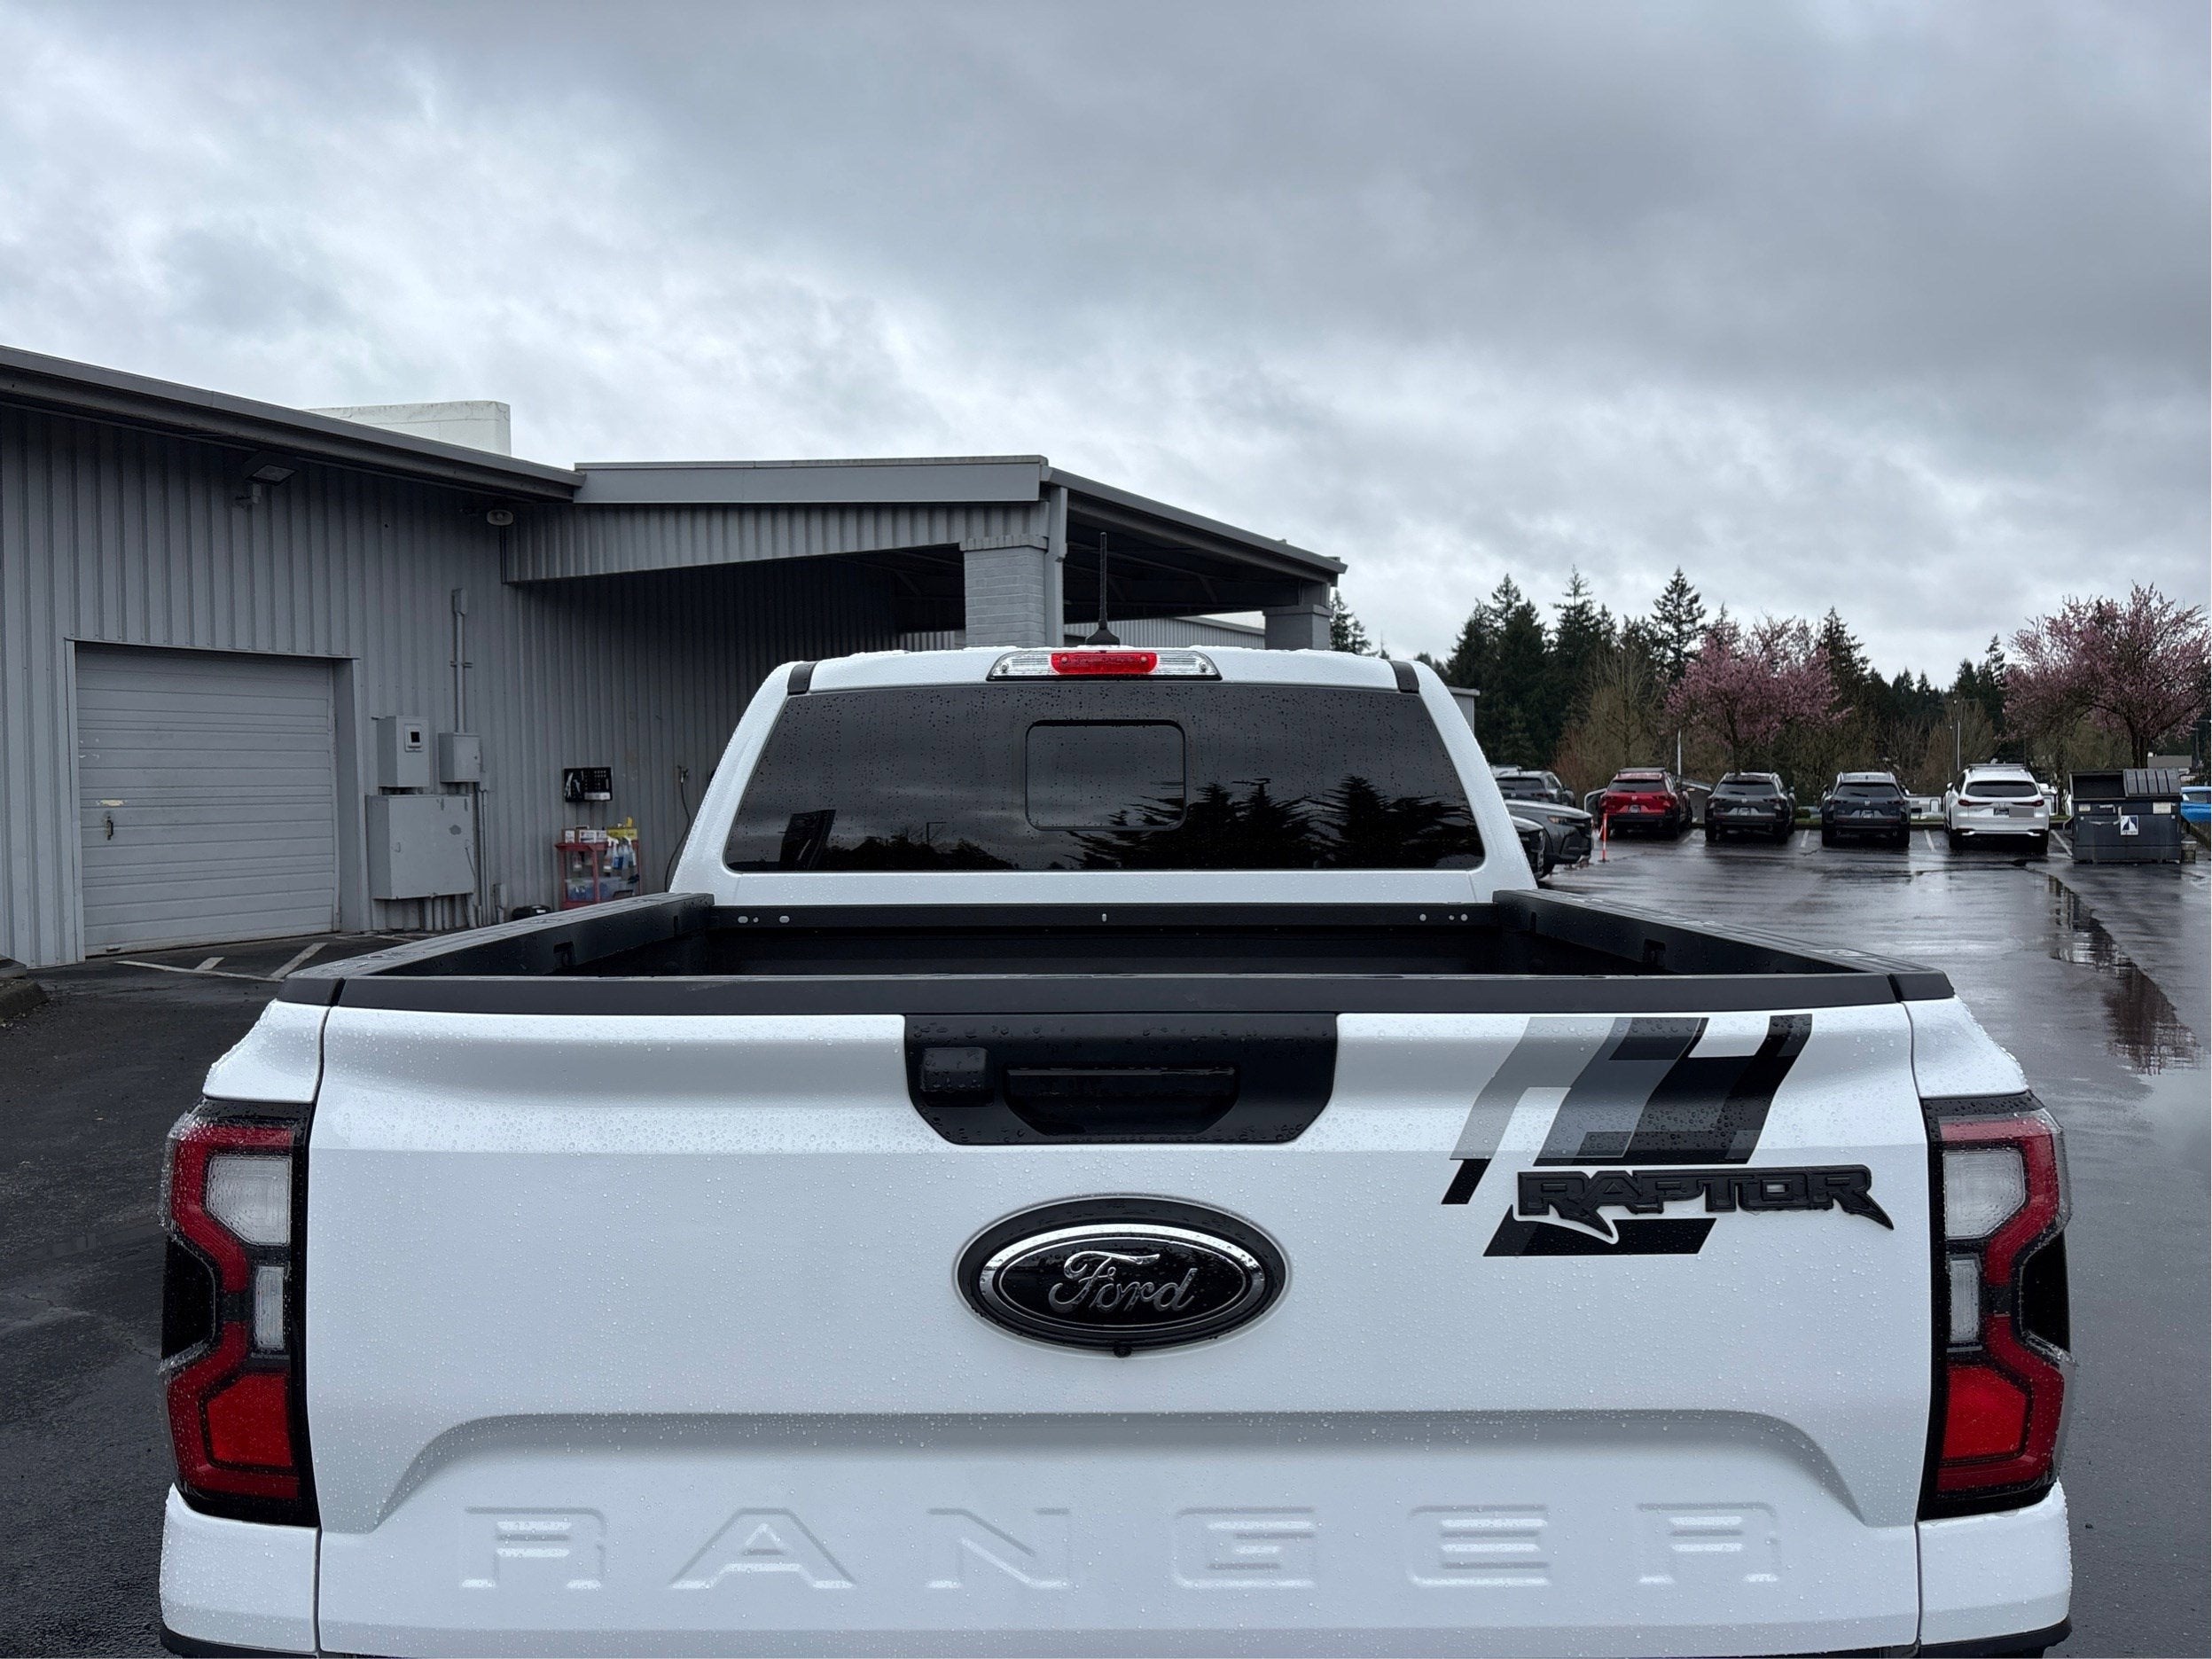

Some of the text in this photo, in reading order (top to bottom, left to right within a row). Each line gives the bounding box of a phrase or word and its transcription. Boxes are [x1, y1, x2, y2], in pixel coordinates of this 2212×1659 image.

[1517, 1163, 1895, 1238] RAPTOR
[1048, 1249, 1198, 1314] Ford
[459, 1501, 1780, 1592] RANGER
